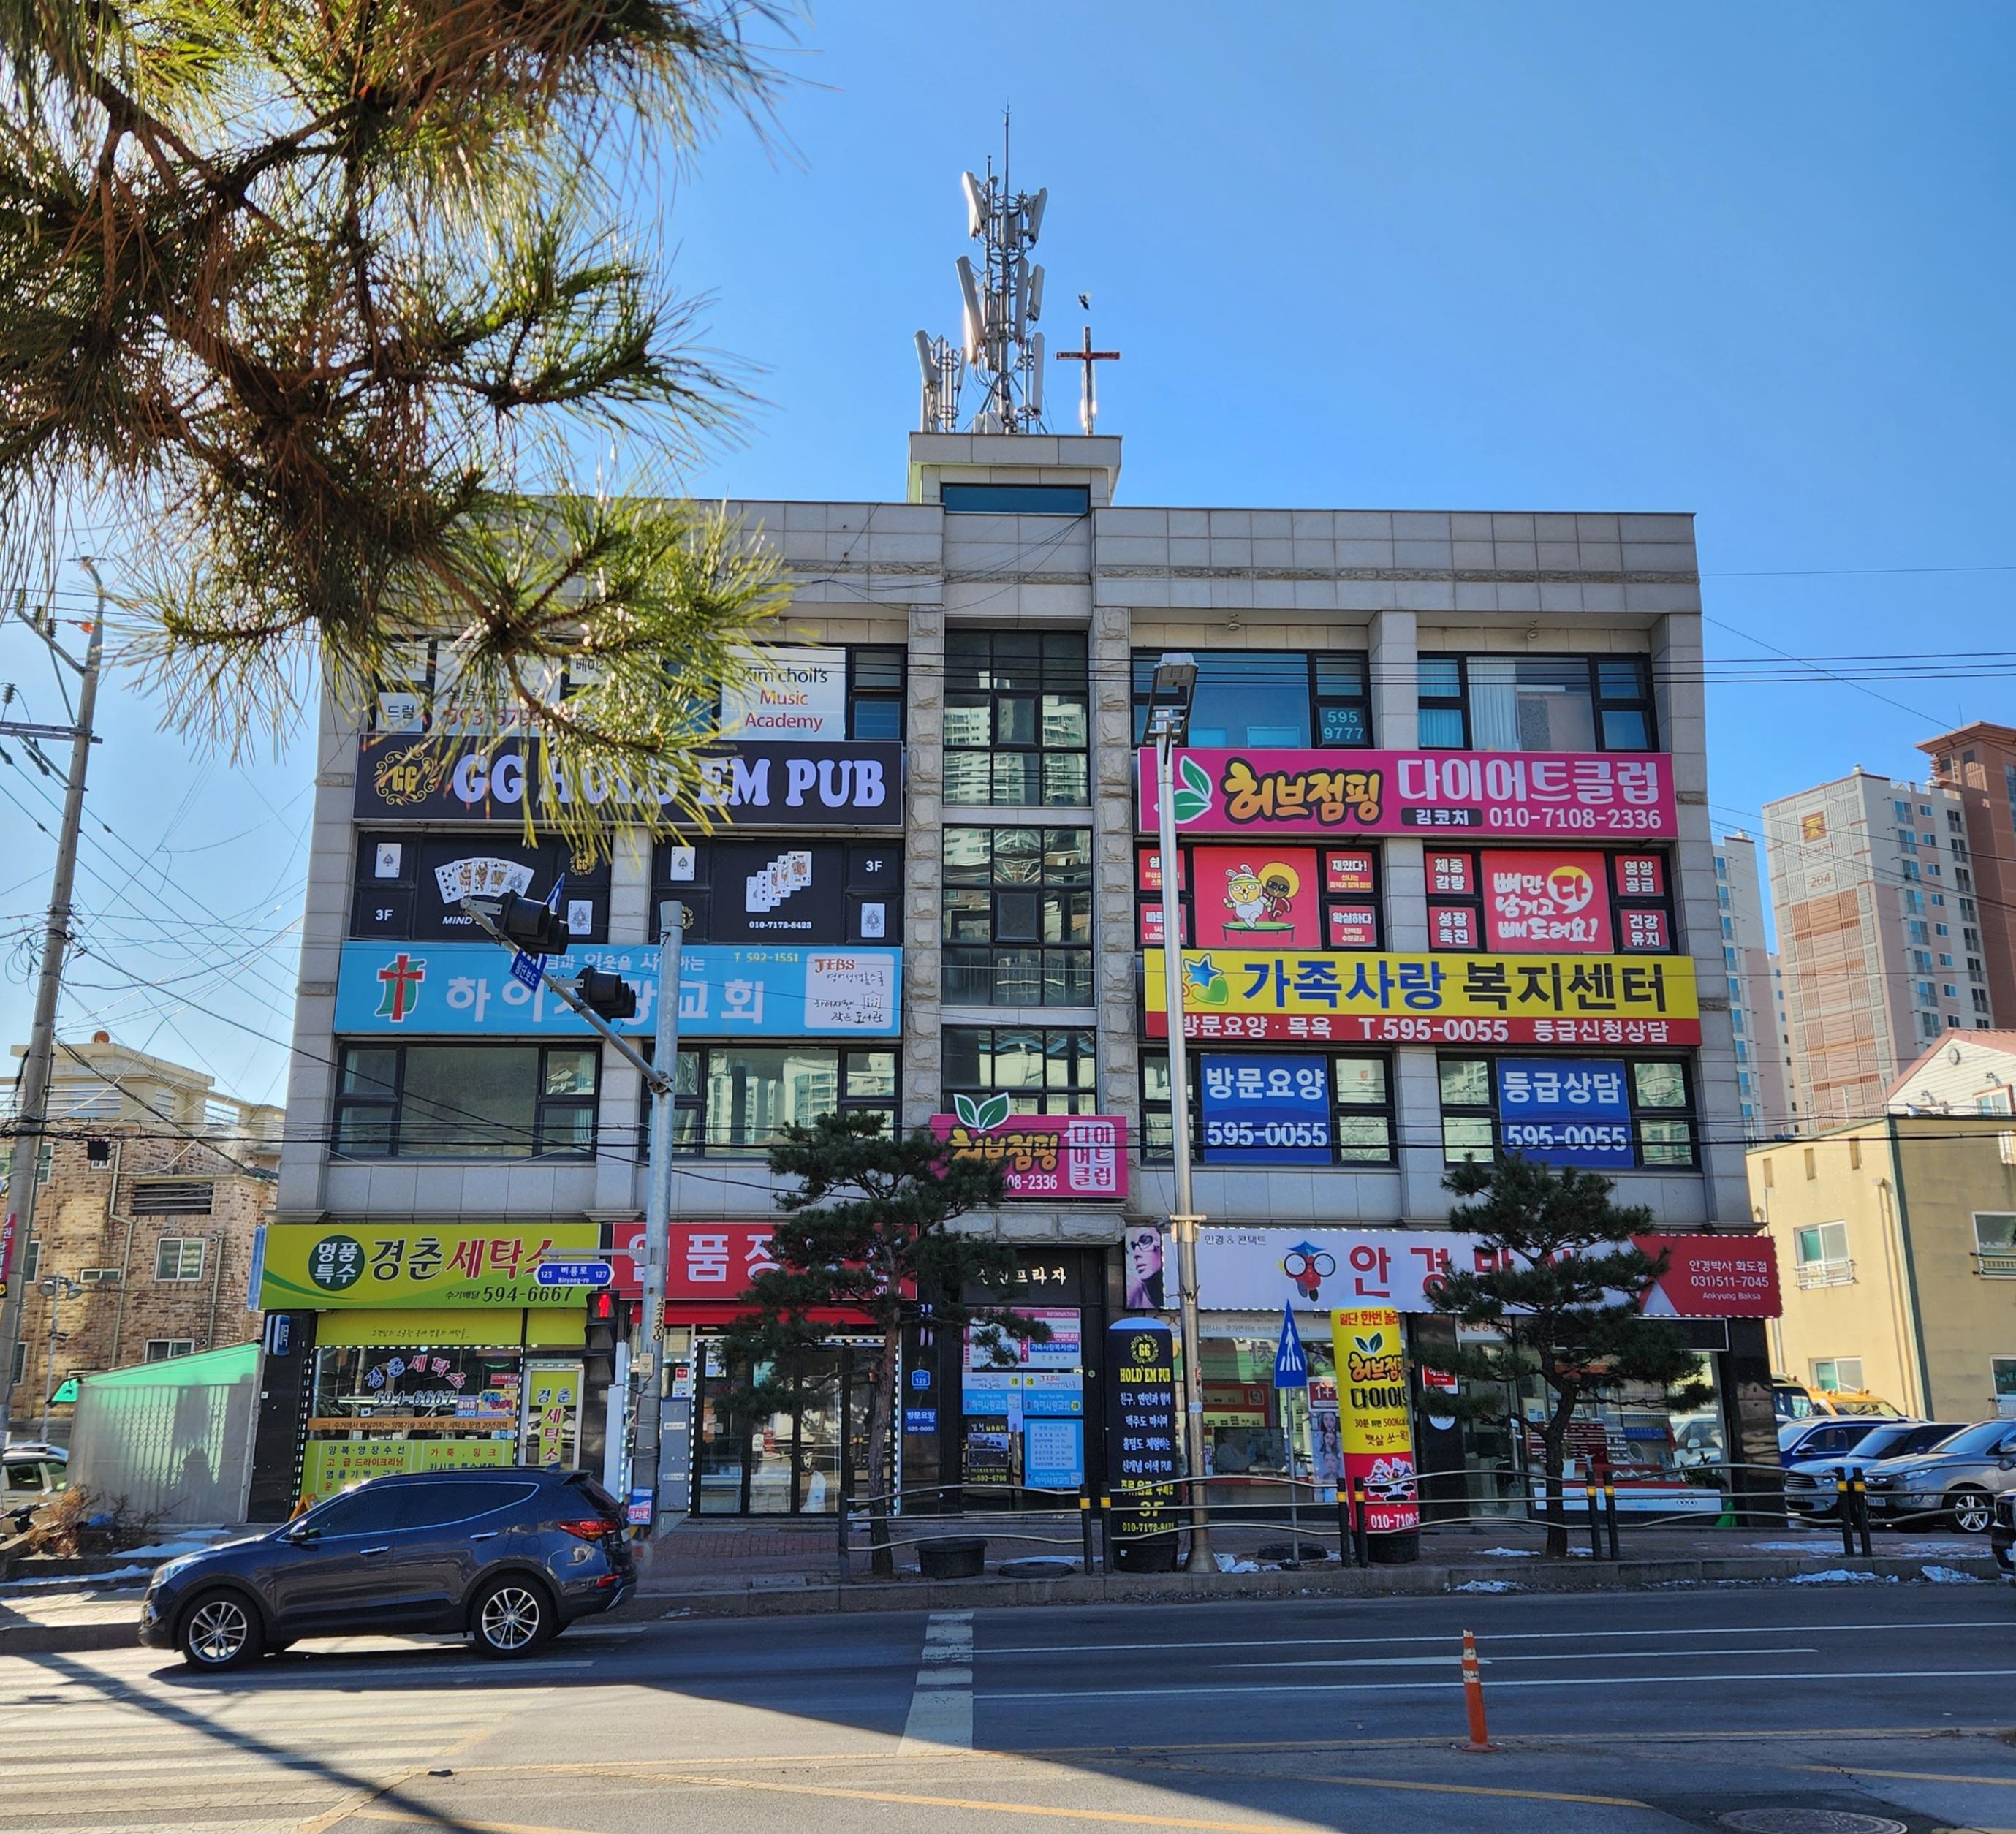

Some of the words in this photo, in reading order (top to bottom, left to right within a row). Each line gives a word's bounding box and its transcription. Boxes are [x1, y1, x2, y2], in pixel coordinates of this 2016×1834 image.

[740, 667, 773, 683] Kim
[778, 667, 827, 683] choil's
[760, 690, 808, 706] Music
[387, 705, 415, 720] 드럼
[1327, 711, 1358, 724] 595
[744, 712, 824, 732] Academy
[1323, 727, 1365, 740] 9777
[391, 765, 418, 792] GG
[452, 753, 526, 804] GG
[785, 759, 886, 808] PUB
[1397, 758, 1659, 805] 다이어트클럽
[1222, 758, 1382, 824] 허브점핑
[1415, 808, 1470, 826] 김코치
[1488, 806, 1662, 830] 010-7108-2336
[865, 860, 883, 872] 3F
[1332, 859, 1368, 872] 재밌다!
[1434, 857, 1463, 874] 체중
[1624, 860, 1653, 876] 영양
[1435, 874, 1466, 890] 감량
[1493, 872, 1545, 895] 뼈만
[1625, 877, 1655, 893] 공급
[1811, 872, 1832, 888] 204
[1495, 895, 1557, 918] 남기고
[1551, 875, 1589, 906] 다
[374, 909, 394, 922] 3F
[442, 916, 473, 925] MIND
[1438, 912, 1468, 927] 성장
[1629, 914, 1659, 930] 건강
[749, 920, 812, 930] 010-7172-8423
[1439, 928, 1469, 944] 촉진
[1630, 931, 1660, 947] 유지
[640, 953, 705, 971] 사하는
[746, 952, 799, 963] 592-1551
[515, 958, 538, 986] 횡단보도
[814, 958, 855, 974] JEBS
[1243, 959, 1447, 1010] 가족사랑
[1463, 961, 1667, 1012] 복지센터
[446, 977, 765, 1024] 하이교회
[1184, 1015, 1268, 1038] 방문요양
[1287, 1017, 1333, 1039] 목욕
[1357, 1018, 1509, 1042] T.595-0055
[1532, 1019, 1670, 1043] 등급신청상담
[1206, 1067, 1325, 1100] 방문요양
[1503, 1071, 1621, 1104] 등급상담
[1208, 1121, 1327, 1147] 595-0055
[1507, 1125, 1627, 1152] 595-0055
[950, 1128, 1059, 1171] 허브점핑
[1004, 1174, 1058, 1190] 08-2336
[1204, 1234, 1225, 1246] 안경
[1238, 1235, 1266, 1246] 콘택트
[317, 1243, 358, 1263] 명품
[314, 1264, 357, 1284] 특수
[541, 1270, 553, 1278] 123
[561, 1266, 588, 1277] 비룡로
[596, 1270, 607, 1278] 127
[1689, 1259, 1732, 1274] 안경박사
[1735, 1259, 1768, 1274] 화도점
[1691, 1275, 1770, 1288] 031)511-7045
[482, 1285, 573, 1303] 594-6667
[1702, 1291, 1737, 1302] Ankyung
[1738, 1291, 1762, 1300] Baksa
[1340, 1311, 1358, 1326] 일단
[1360, 1310, 1382, 1326] 한번
[1138, 1344, 1151, 1357] GG
[365, 1354, 467, 1389] 경춘세탁소
[1158, 1368, 1171, 1383] PUB
[374, 1390, 456, 1407] 594-6667
[537, 1388, 572, 1404] 경춘
[1137, 1392, 1159, 1406] 연인과
[906, 1412, 936, 1420] 방문요양
[1125, 1414, 1148, 1428] 맥주도
[1149, 1414, 1168, 1428] 마시며
[542, 1407, 562, 1462] 세탁소
[355, 1458, 403, 1467] 드라이크리닝
[1123, 1459, 1143, 1474] 신개념
[1144, 1459, 1159, 1474] 이색
[1160, 1460, 1172, 1472] PUB
[1139, 1501, 1164, 1517] 3F
